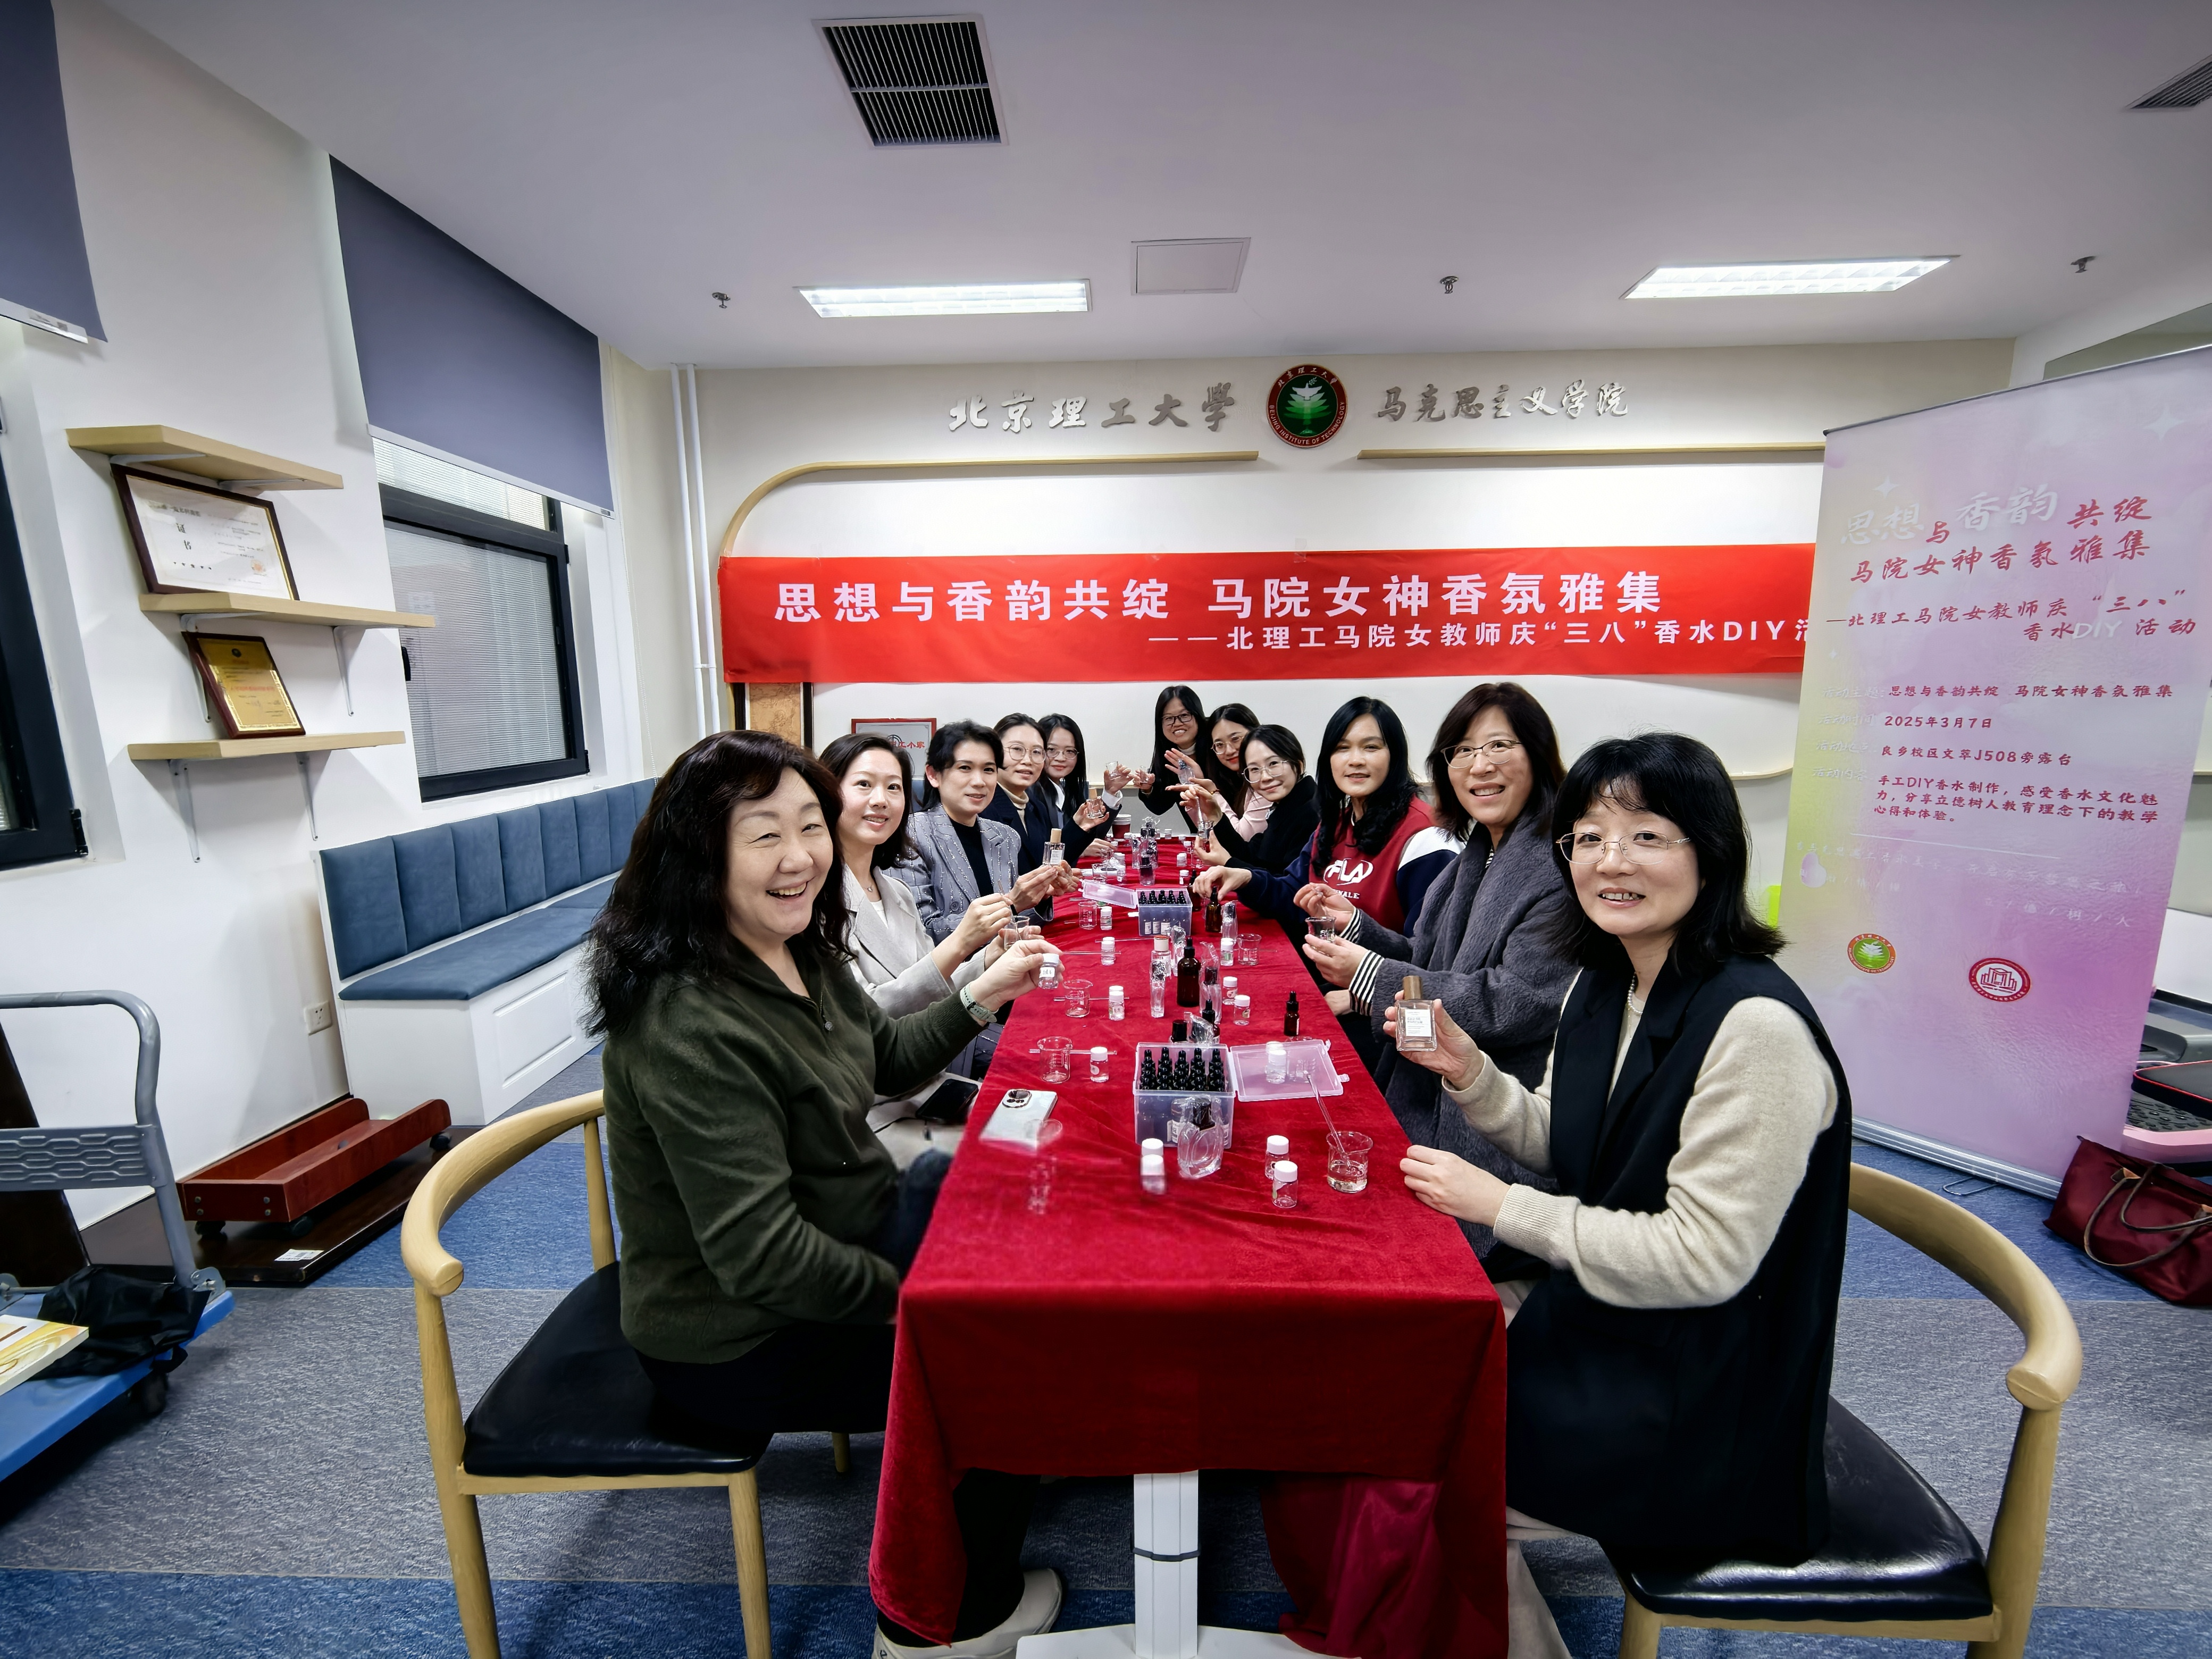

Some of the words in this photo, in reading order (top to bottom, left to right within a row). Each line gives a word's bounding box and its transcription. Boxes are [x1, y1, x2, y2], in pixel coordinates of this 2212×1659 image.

[1278, 366, 1338, 388] 北京理工大
[949, 381, 1234, 433] 北京理工大學
[1376, 379, 1629, 422] 马克思主义学院
[1279, 429, 1310, 445] INSTITUTE
[1321, 401, 1345, 440] TECHNOLOGY
[774, 579, 1169, 623] 思想与香韵共绽
[1208, 570, 1662, 619] 马院女神香氛雅集
[1889, 685, 1999, 697] 思想与香韵共绽
[1884, 716, 1992, 728] 2025年3月7日
[1881, 745, 2072, 766] 良乡校区文萃J508旁露台
